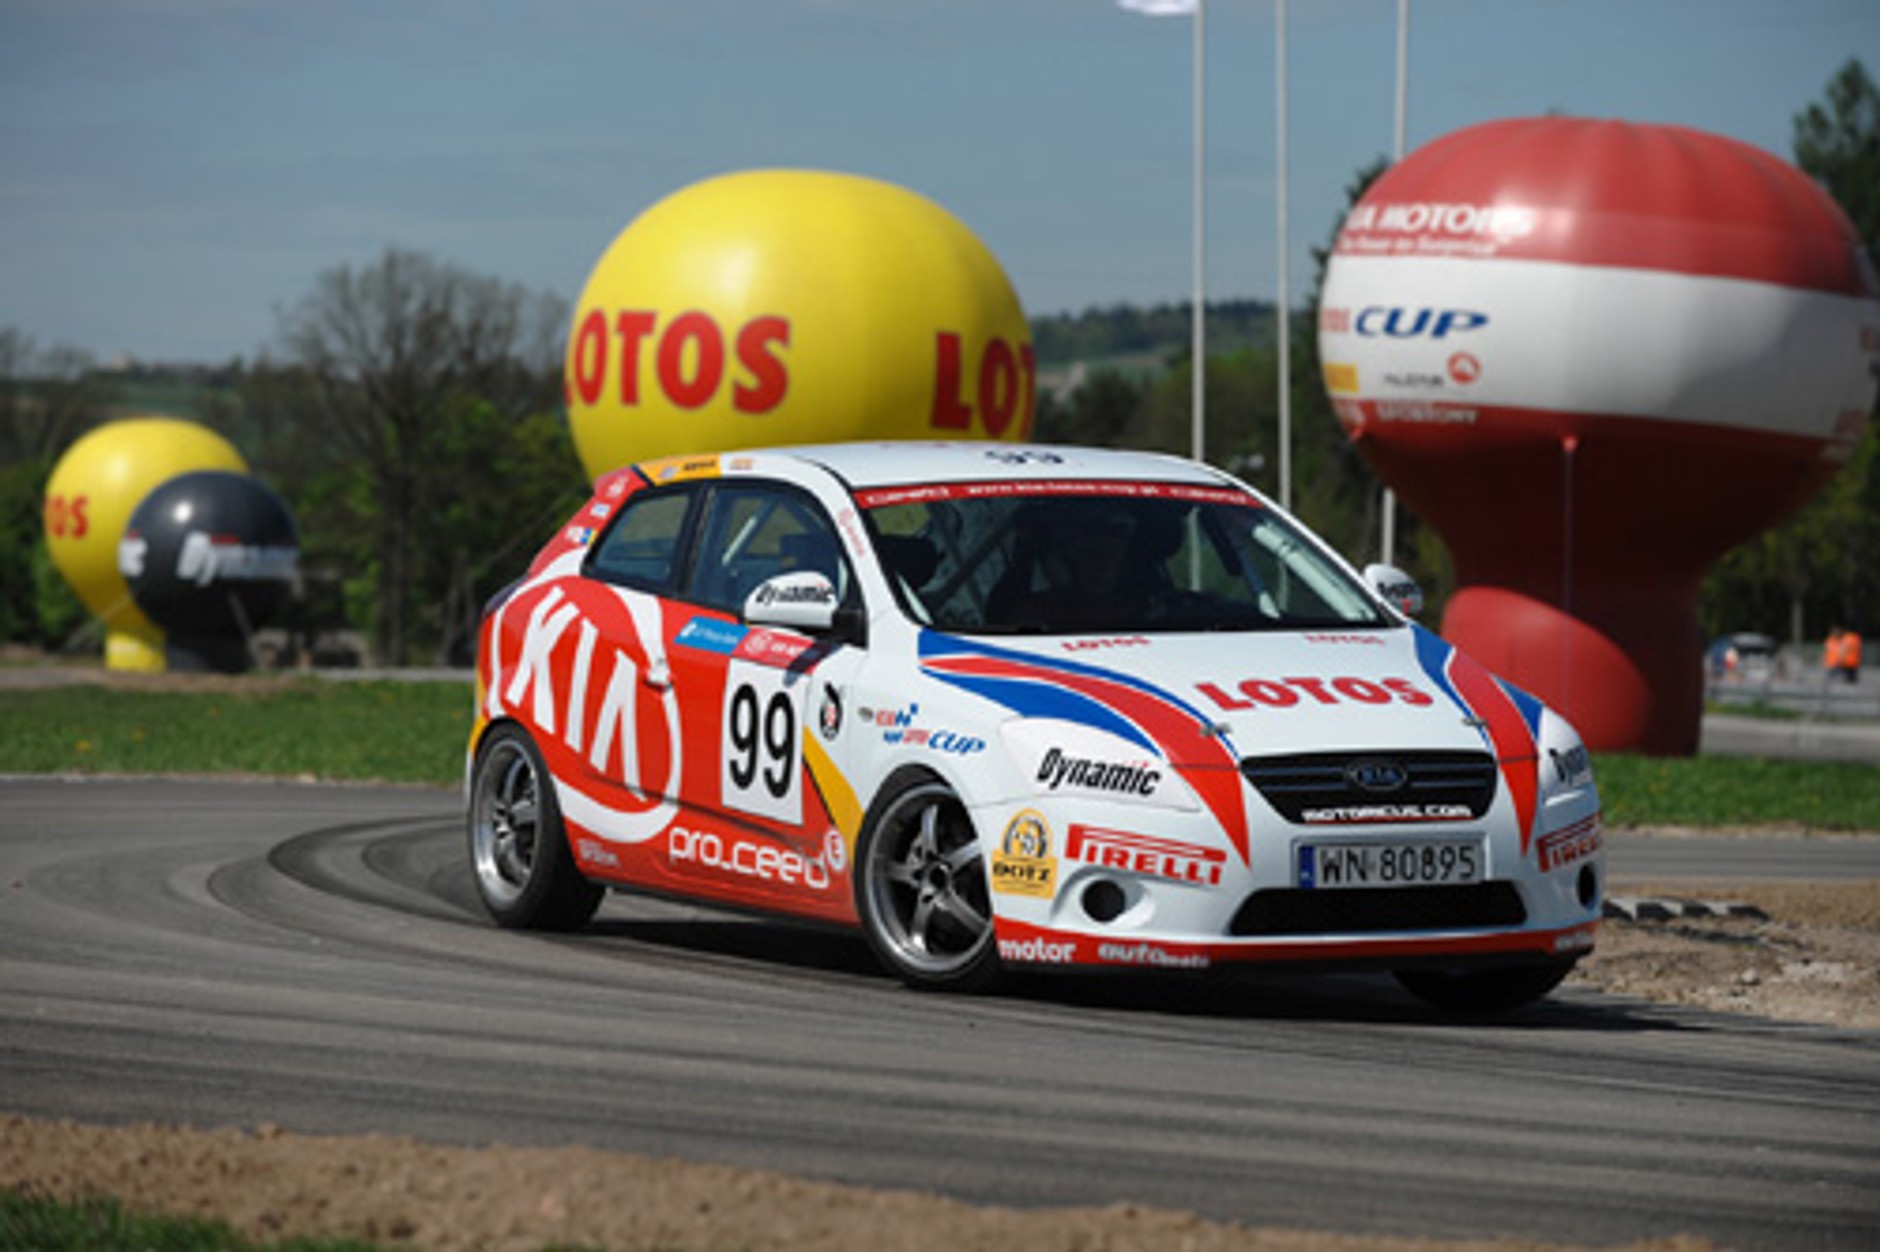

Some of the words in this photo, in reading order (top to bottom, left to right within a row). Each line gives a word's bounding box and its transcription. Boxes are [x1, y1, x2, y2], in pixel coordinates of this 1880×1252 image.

[1355, 306, 1488, 339] CUP
[565, 309, 790, 414] OTOS
[505, 586, 647, 803] KIA
[1194, 676, 1435, 712] LOTOS
[729, 682, 795, 799] 99
[1036, 747, 1162, 796] Dynamic
[1064, 823, 1228, 886] PIRELLI
[1319, 847, 1369, 885] WN
[1379, 845, 1476, 882] 80895
[1000, 935, 1077, 963] motor
